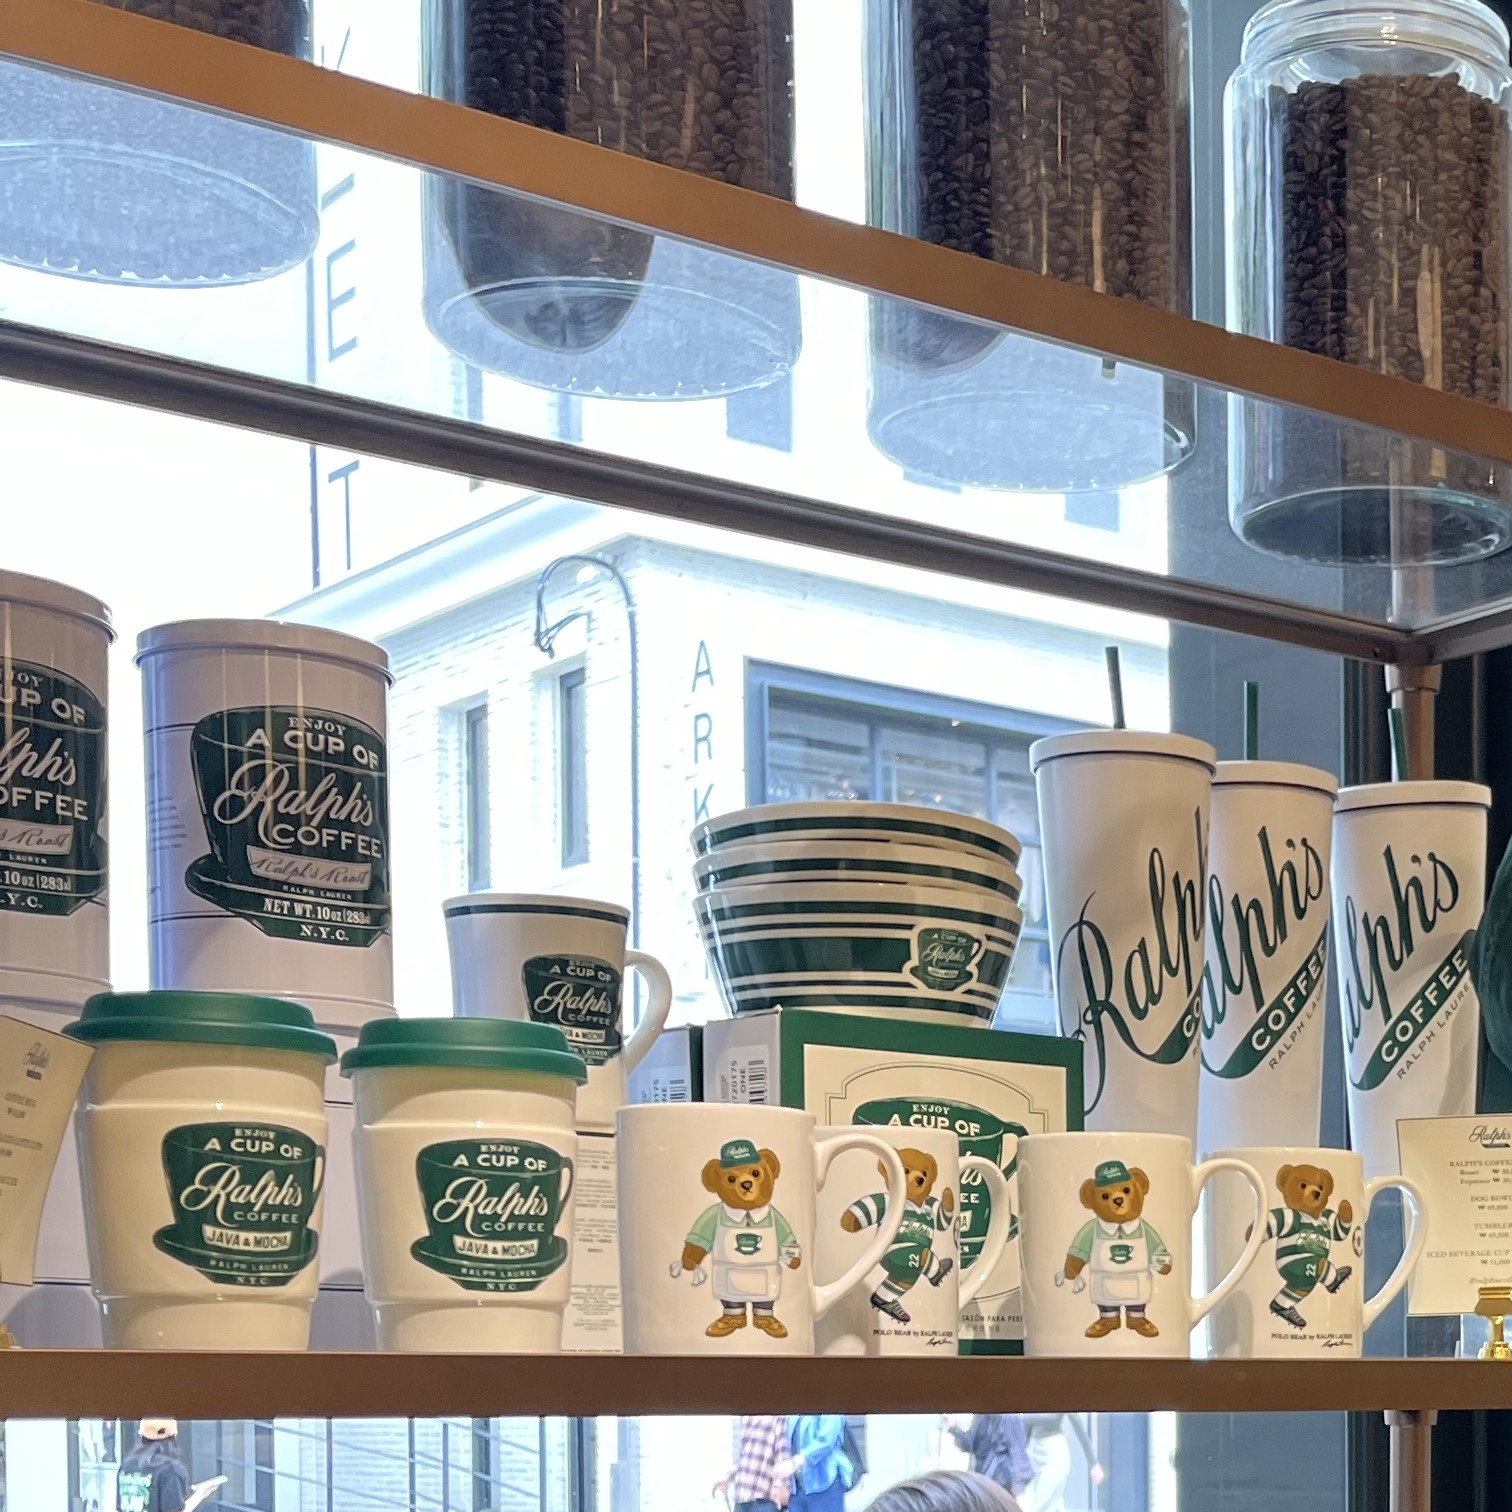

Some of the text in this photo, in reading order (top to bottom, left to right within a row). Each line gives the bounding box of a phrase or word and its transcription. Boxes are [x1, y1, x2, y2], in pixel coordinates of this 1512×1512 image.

[51, 698, 86, 724] OF
[288, 717, 346, 736] ENJOY
[247, 728, 379, 770] A CUP OF
[213, 759, 373, 849] Ralph's
[272, 824, 382, 858] COFFEE
[264, 898, 289, 915] NET
[1200, 826, 1323, 1040] alph's
[1342, 844, 1459, 1053] alph's
[567, 966, 595, 977] CUP
[1252, 941, 1326, 1050] COFFEE
[1381, 949, 1467, 1062] COFFEE
[1397, 984, 1470, 1080] RALPH LAURE
[1268, 1021, 1305, 1070] RALPH
[913, 1104, 950, 1115] ENJOY
[888, 1114, 980, 1136] A CUP OF
[1469, 1125, 1511, 1144] Ralph's
[204, 1138, 303, 1160] A CUP OF
[453, 1153, 548, 1172] A CUP OF
[180, 1162, 303, 1228] Ralph's
[233, 1211, 299, 1224] COFFEE
[432, 1177, 549, 1237] Ralph's
[481, 1222, 546, 1232] COFFEE
[207, 1228, 289, 1249] JAVA MOCHA
[458, 1239, 489, 1255] JAVA
[909, 1253, 920, 1268] 22
[1305, 1263, 1316, 1277] 22
